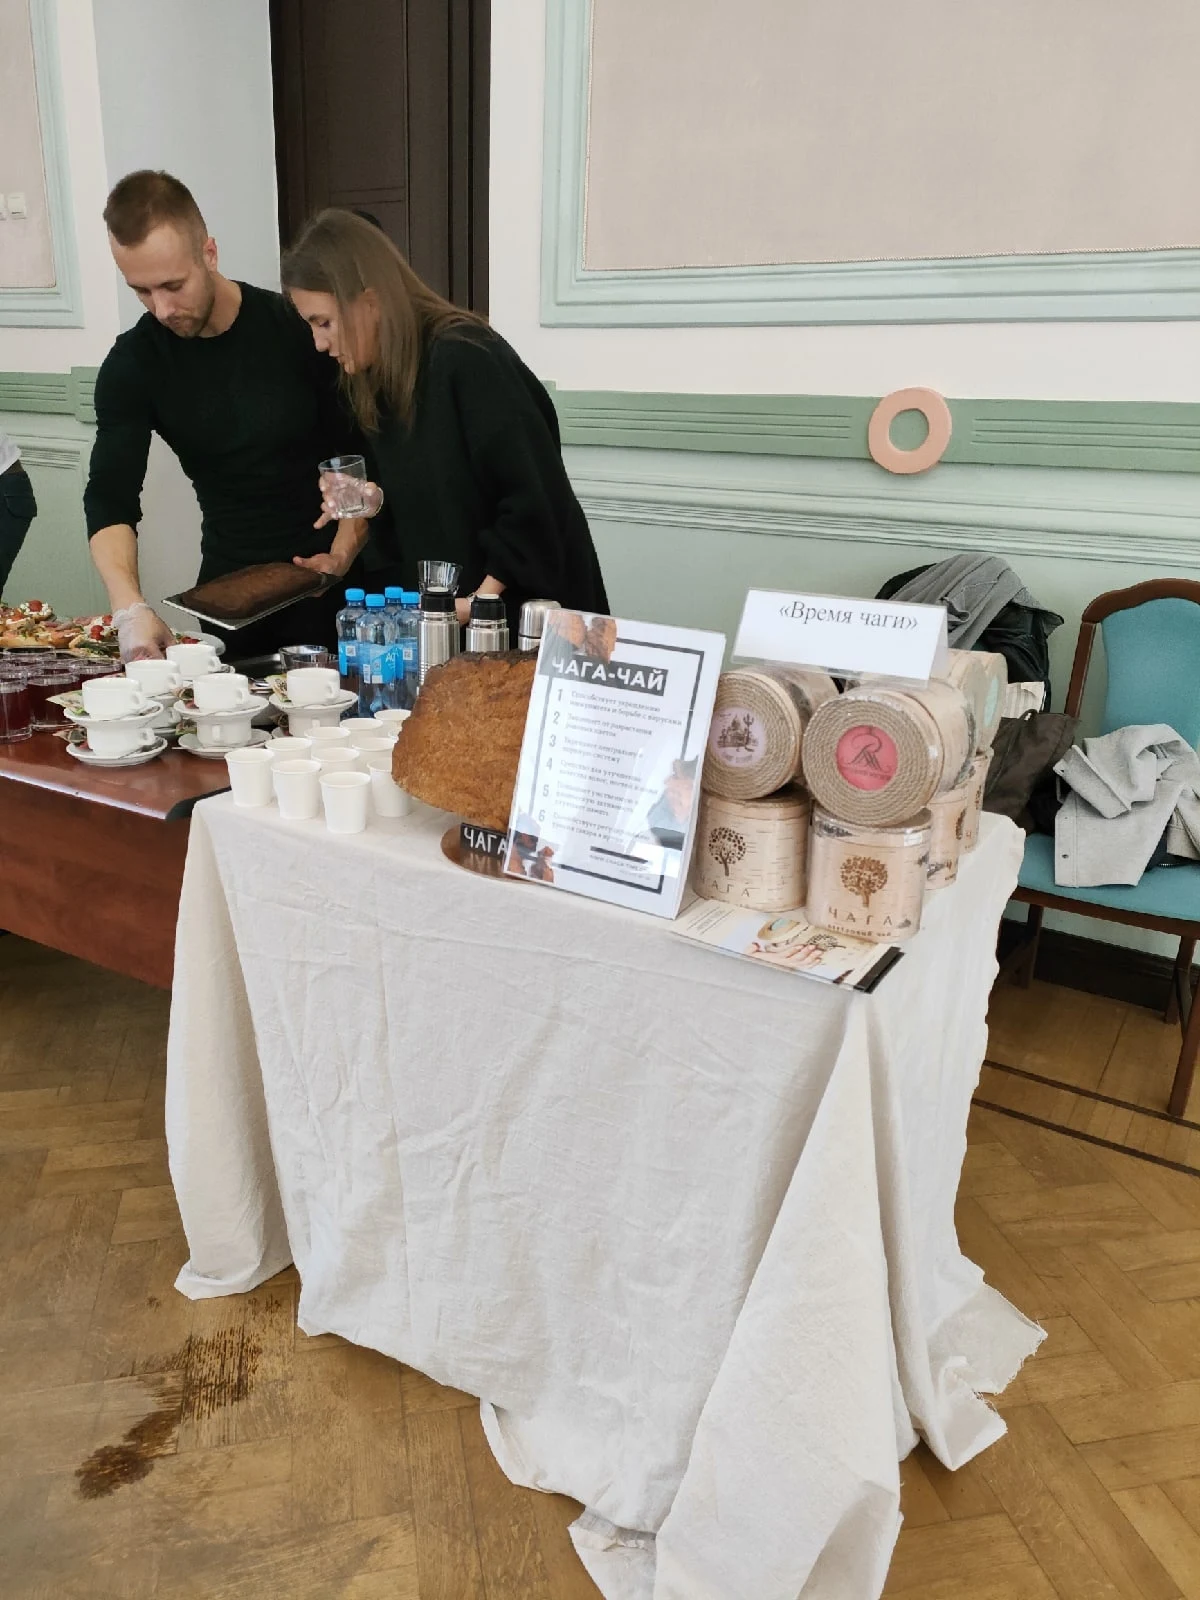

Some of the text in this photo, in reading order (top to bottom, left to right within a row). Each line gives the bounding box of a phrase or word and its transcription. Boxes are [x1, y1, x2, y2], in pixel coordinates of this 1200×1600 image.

[779, 600, 918, 630] «Время чаги»
[551, 656, 664, 692] ЧАГА-ЧАЙ
[558, 689, 563, 702] 1
[553, 711, 560, 725] 2
[549, 734, 556, 748] 3
[546, 757, 553, 771] 4
[542, 784, 549, 798] 5
[539, 809, 546, 822] 6
[464, 827, 508, 855] ЧАГА
[828, 906, 893, 926] ЧАГА
